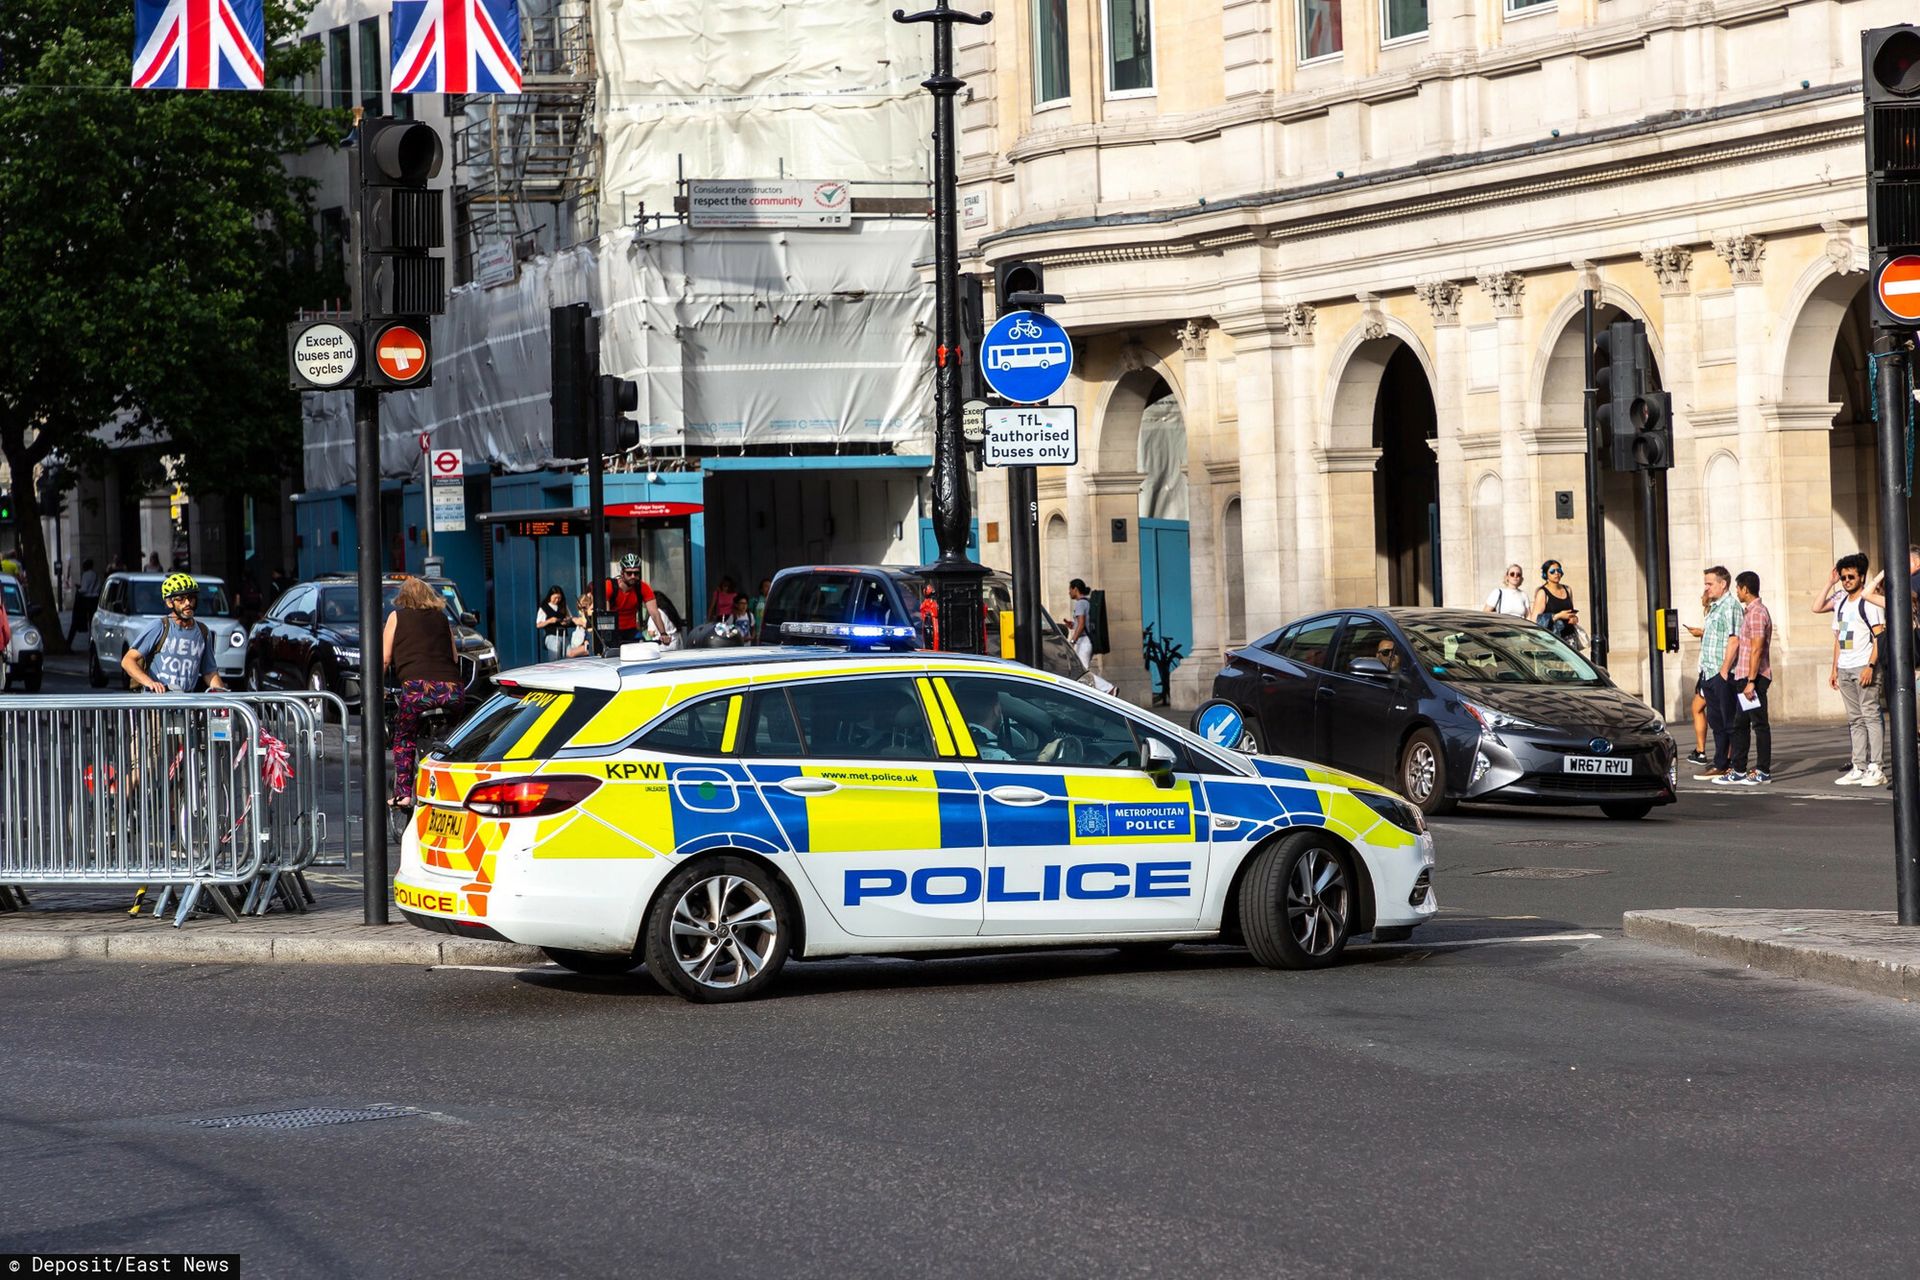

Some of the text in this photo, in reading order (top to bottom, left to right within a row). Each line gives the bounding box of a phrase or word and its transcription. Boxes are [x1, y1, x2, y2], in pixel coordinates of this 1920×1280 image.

[693, 185, 783, 194] Considerate constructors
[693, 196, 804, 208] respect the community
[306, 335, 343, 348] Except
[297, 348, 353, 362] buses and
[309, 363, 344, 377] cycles
[963, 408, 984, 416] Excep
[1018, 414, 1042, 426] TfL
[423, 435, 429, 448] K
[991, 429, 1069, 442] authorised
[991, 445, 1070, 459] buses only
[160, 635, 205, 658] NEW
[517, 692, 558, 708] KPW
[605, 763, 661, 779] KPW
[1570, 758, 1628, 774] WR67 RYU
[821, 771, 919, 783] www.met.police.uk
[1115, 807, 1185, 817] METROPOLITAN
[445, 815, 463, 836] FMJ
[1126, 820, 1176, 830] POLICE
[844, 861, 1192, 907] POLICE
